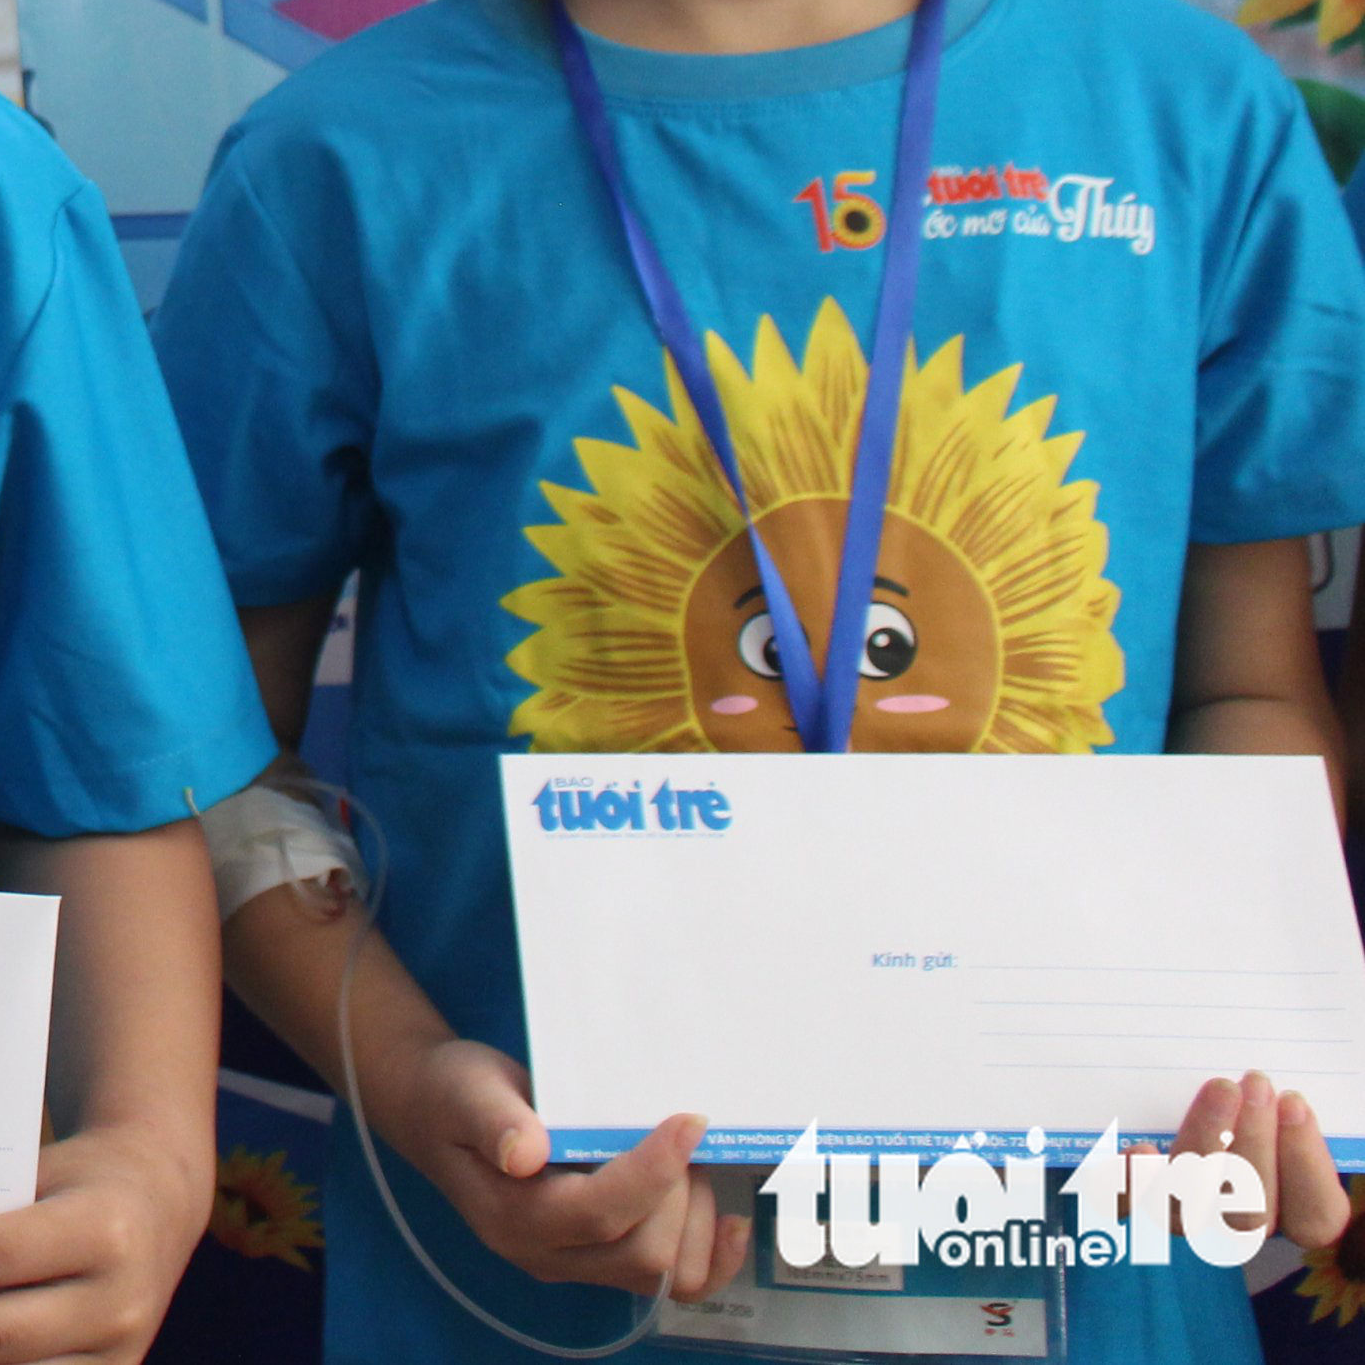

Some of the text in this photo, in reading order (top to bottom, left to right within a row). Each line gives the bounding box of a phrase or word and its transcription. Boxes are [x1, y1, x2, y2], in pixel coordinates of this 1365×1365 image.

[792, 169, 887, 253] 15
[1047, 174, 1155, 256] Thúy
[531, 778, 732, 832] tuổi trẻ
[872, 951, 916, 968] Kính
